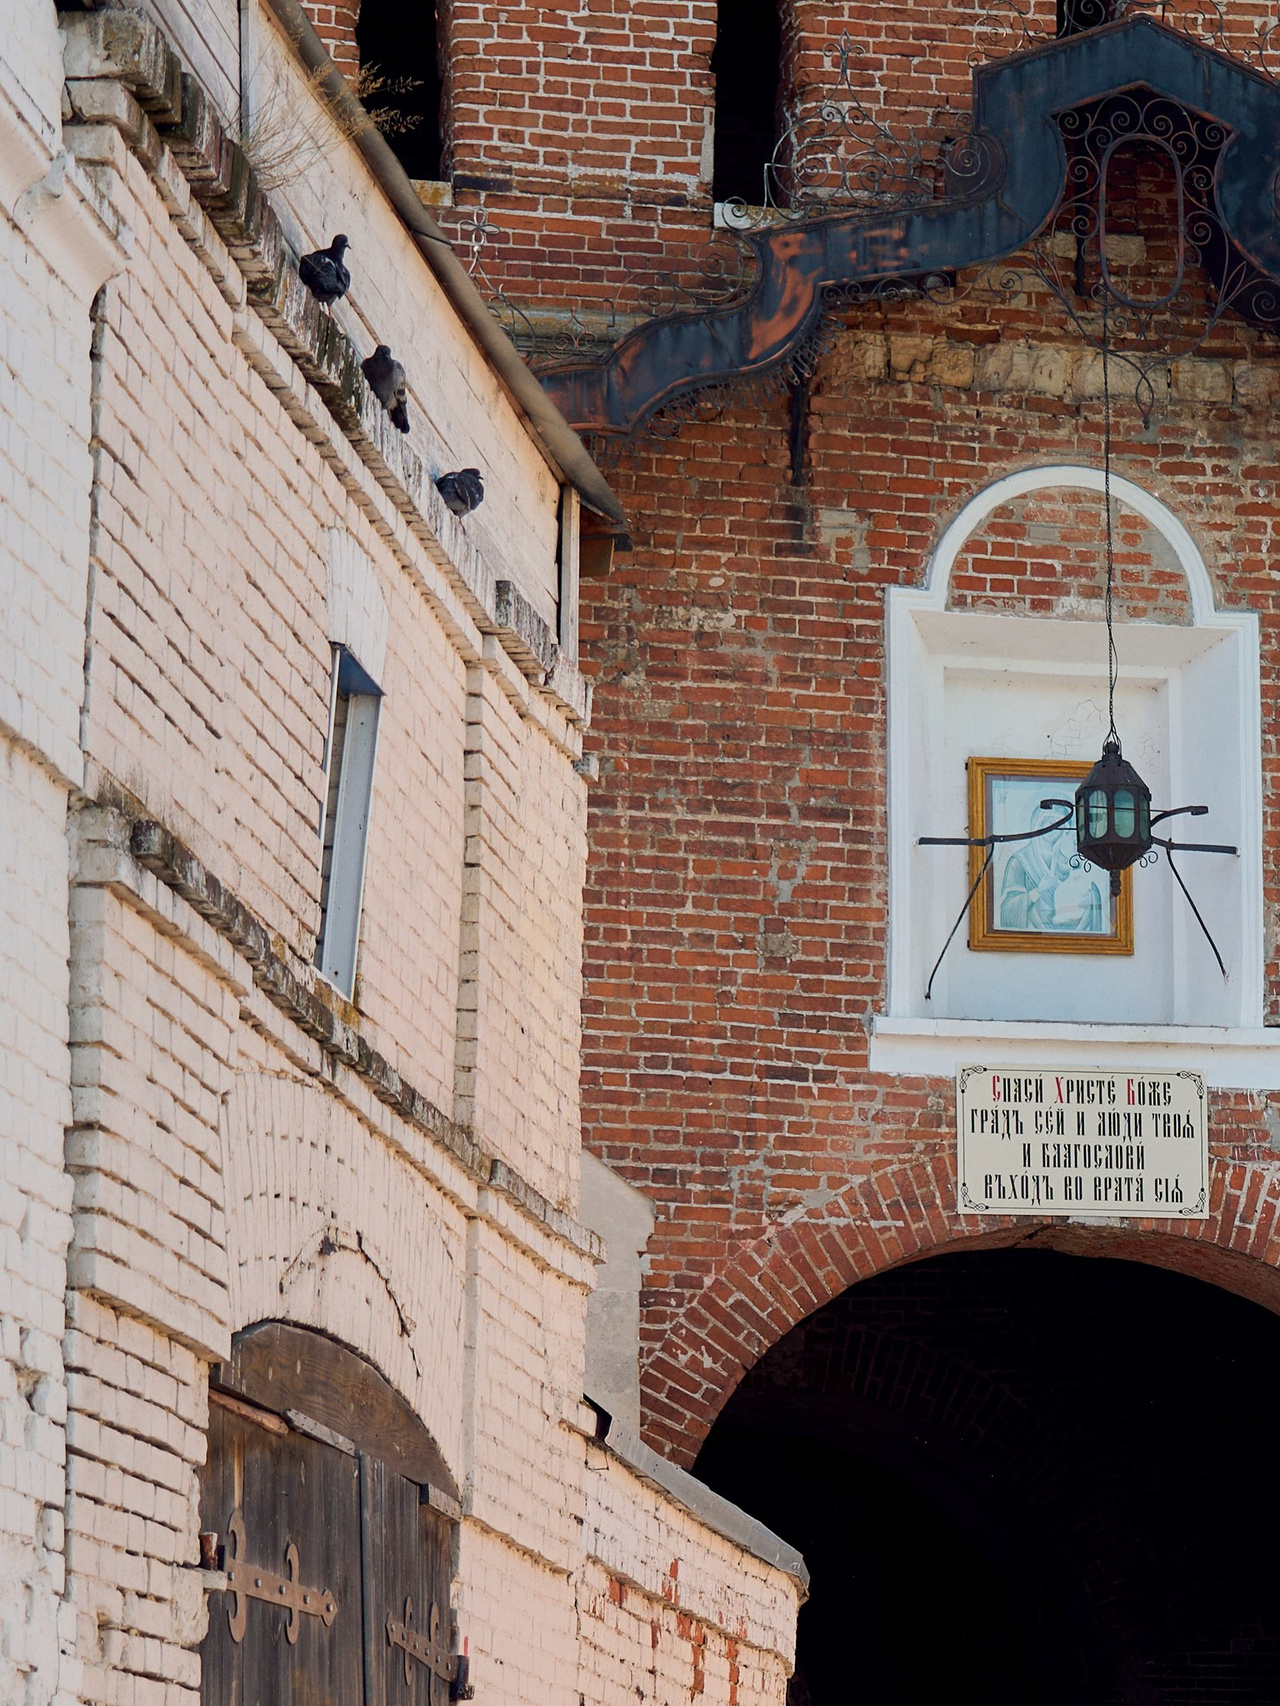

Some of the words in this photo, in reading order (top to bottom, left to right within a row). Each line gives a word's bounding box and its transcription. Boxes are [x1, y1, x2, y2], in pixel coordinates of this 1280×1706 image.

[1077, 1111, 1085, 1136] и
[1022, 1143, 1031, 1168] и
[1064, 1175, 1083, 1201] во
